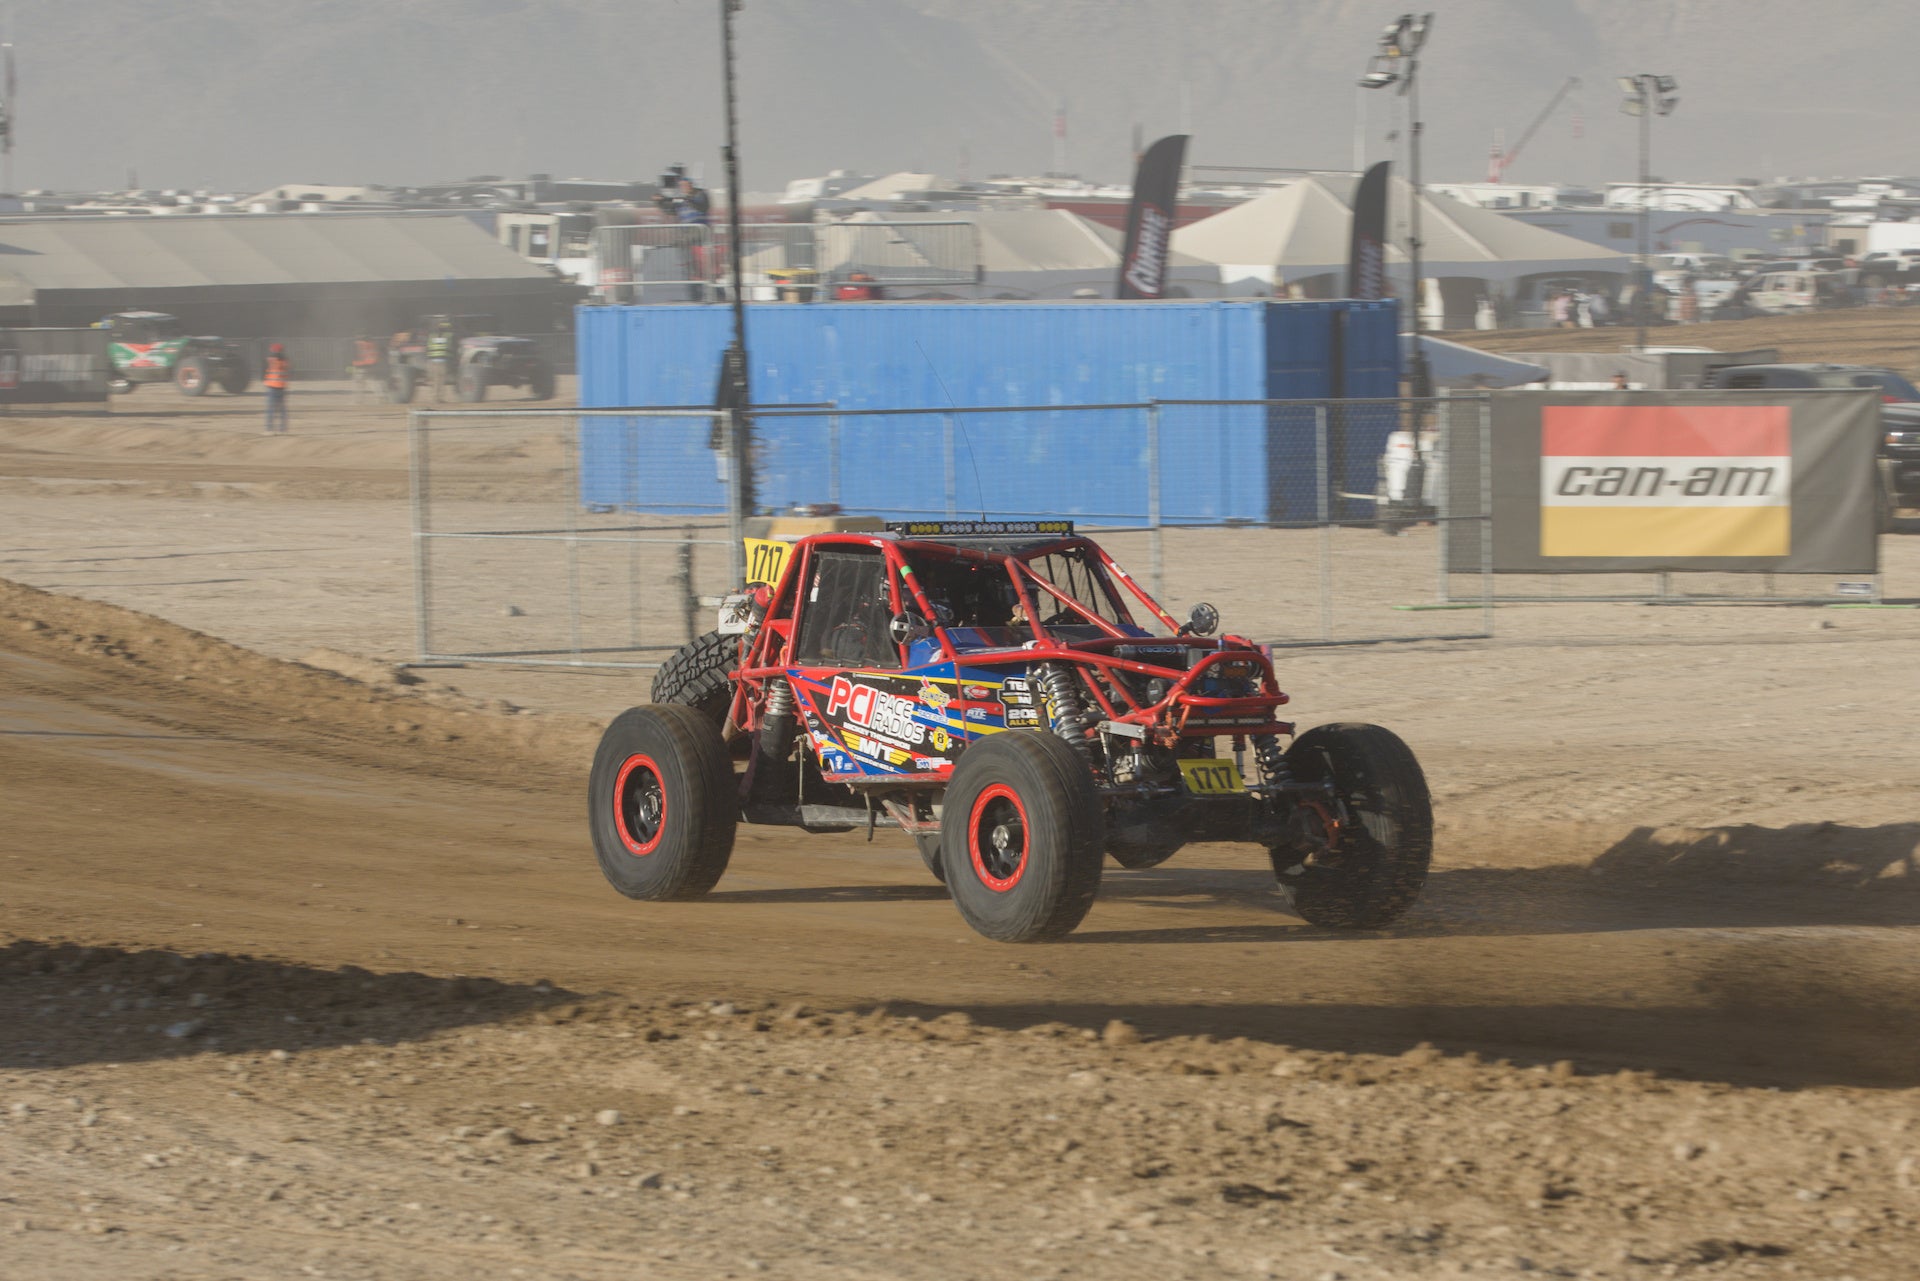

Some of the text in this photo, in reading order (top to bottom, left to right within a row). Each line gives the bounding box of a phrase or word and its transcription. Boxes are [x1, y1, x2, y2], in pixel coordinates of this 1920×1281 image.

[1555, 466, 1775, 497] can-am
[751, 543, 783, 583] 1717
[827, 676, 878, 727] PCI
[876, 691, 914, 719] RACE
[872, 711, 926, 743] RADIOS
[937, 732, 945, 744] 8
[1190, 766, 1234, 789] 1717
